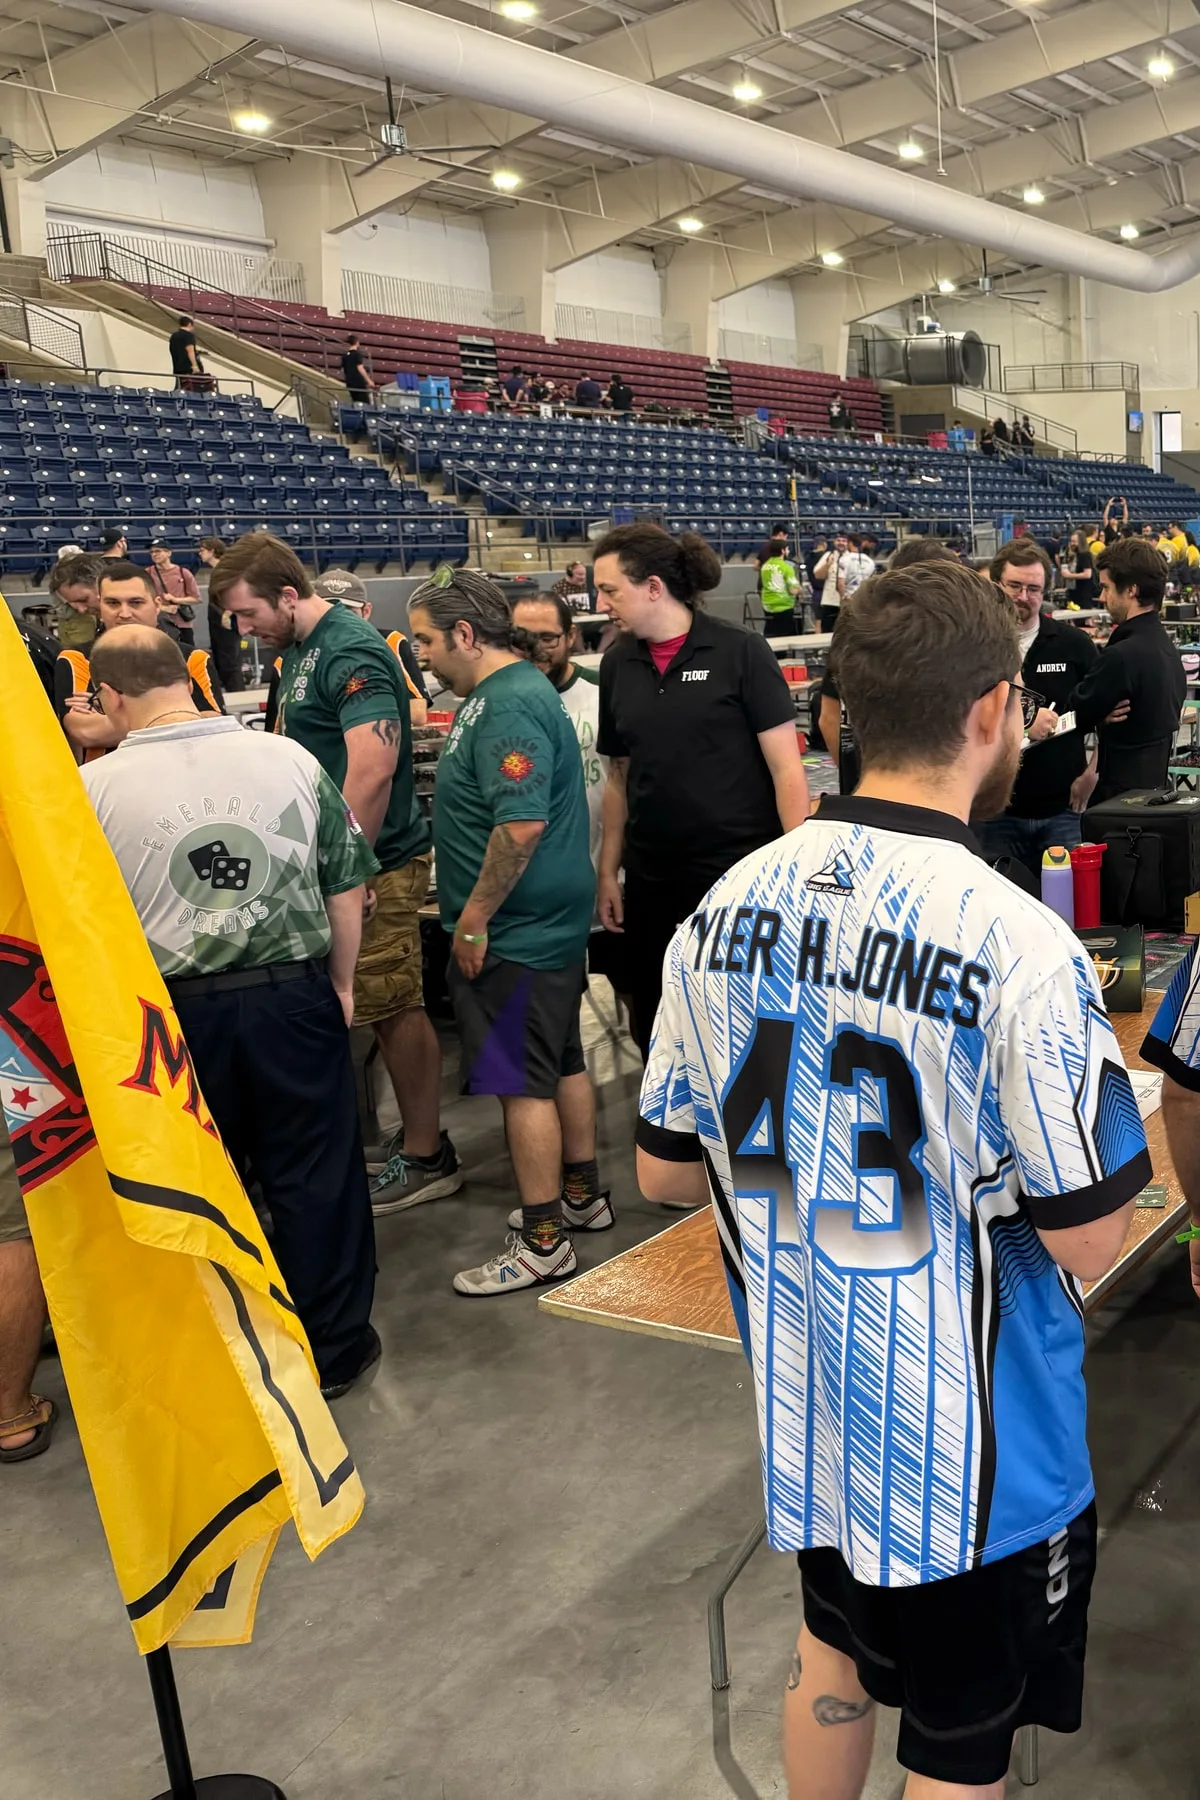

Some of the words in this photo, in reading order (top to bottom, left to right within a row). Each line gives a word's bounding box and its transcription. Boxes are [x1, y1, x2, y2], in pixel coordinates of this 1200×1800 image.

[1036, 663, 1067, 673] ANDREW
[141, 796, 282, 852] EMERALD
[176, 900, 270, 936] DREAMS
[717, 1010, 940, 1275] 43
